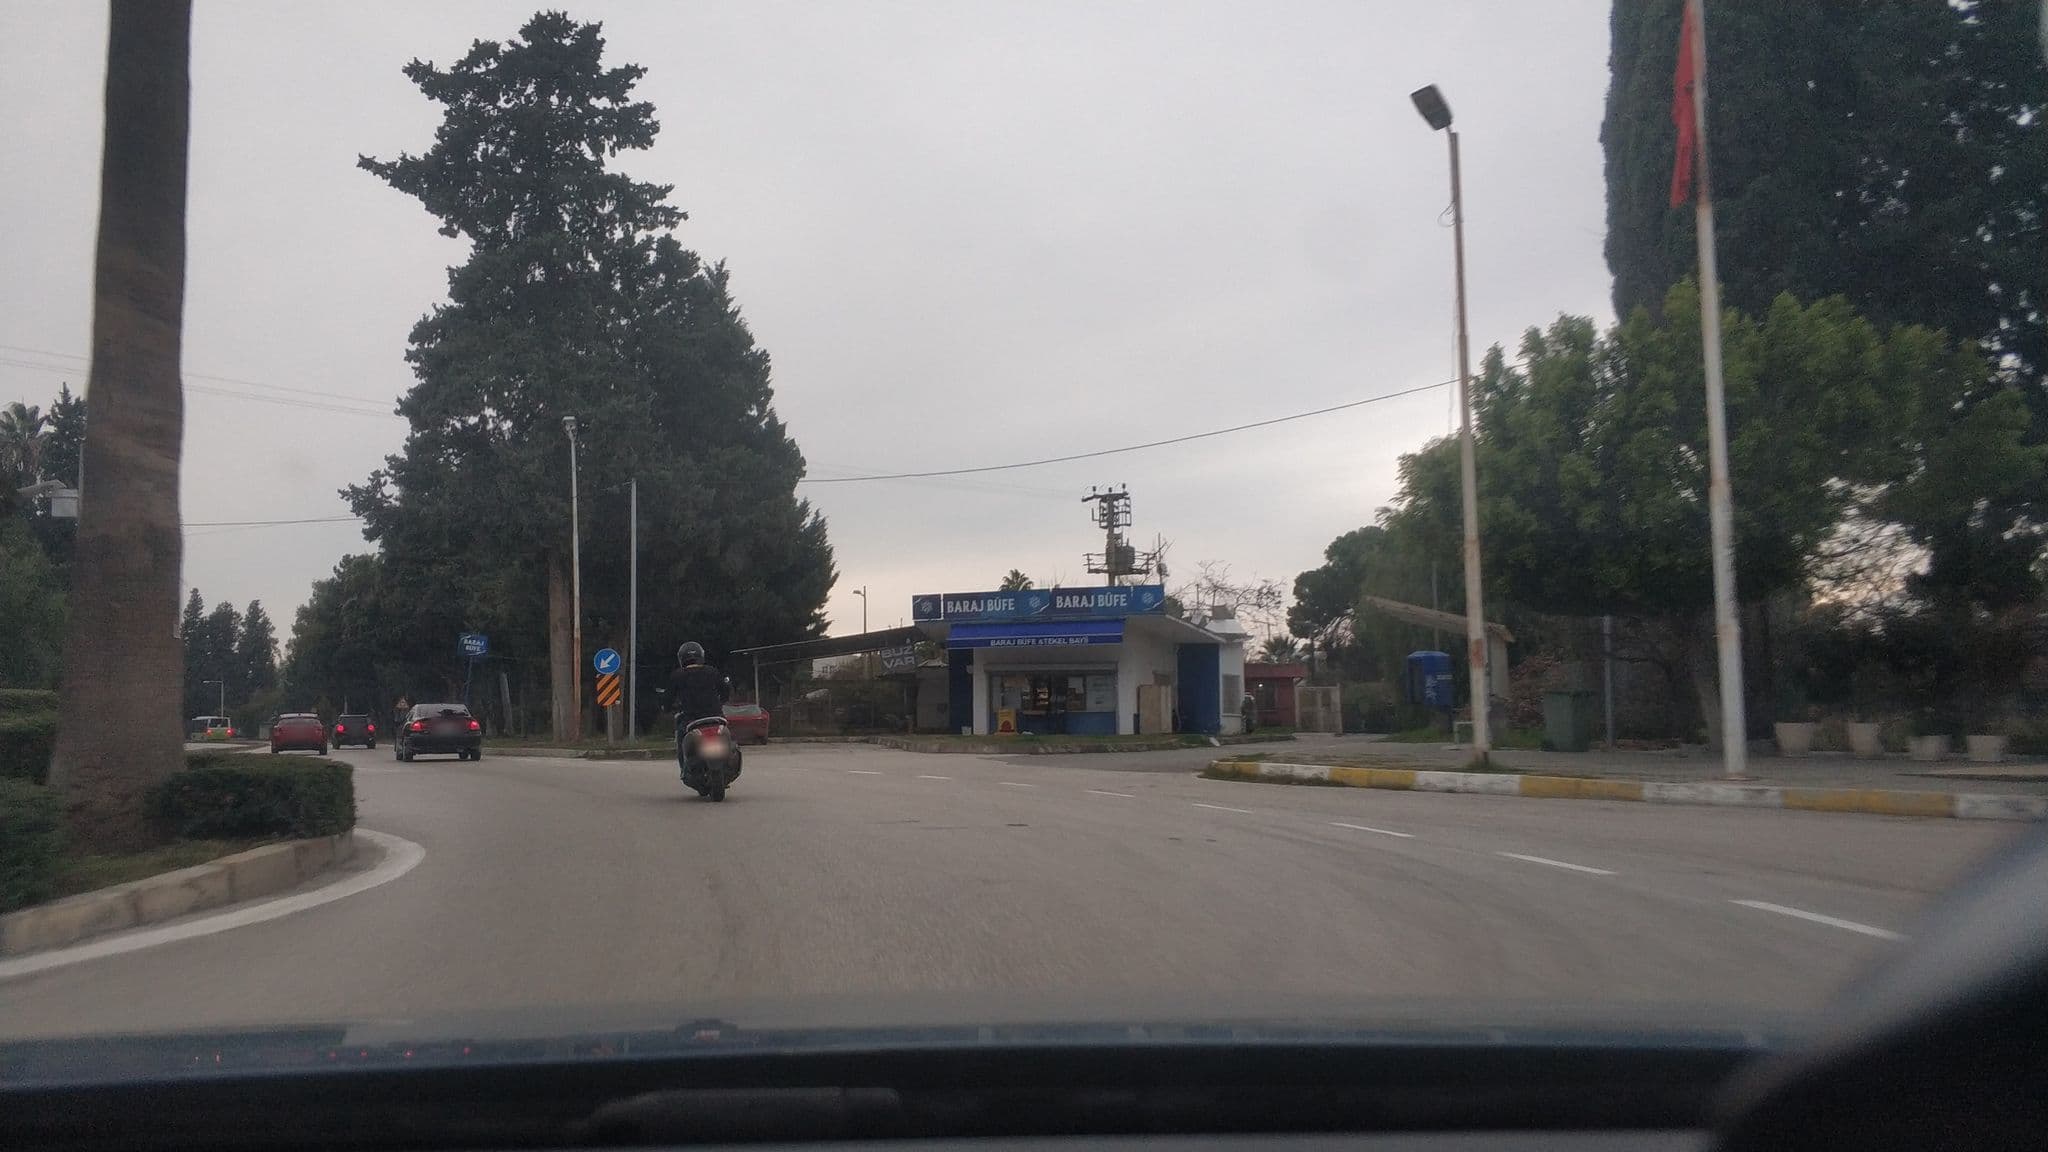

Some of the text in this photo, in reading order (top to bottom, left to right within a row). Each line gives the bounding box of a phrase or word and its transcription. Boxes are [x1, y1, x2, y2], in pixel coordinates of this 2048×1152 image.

[947, 598, 1015, 613] BARAJ BÜFE
[1056, 592, 1127, 609] BARAJ BÜFE
[881, 645, 913, 658] BUZ
[882, 656, 915, 668] VAR
